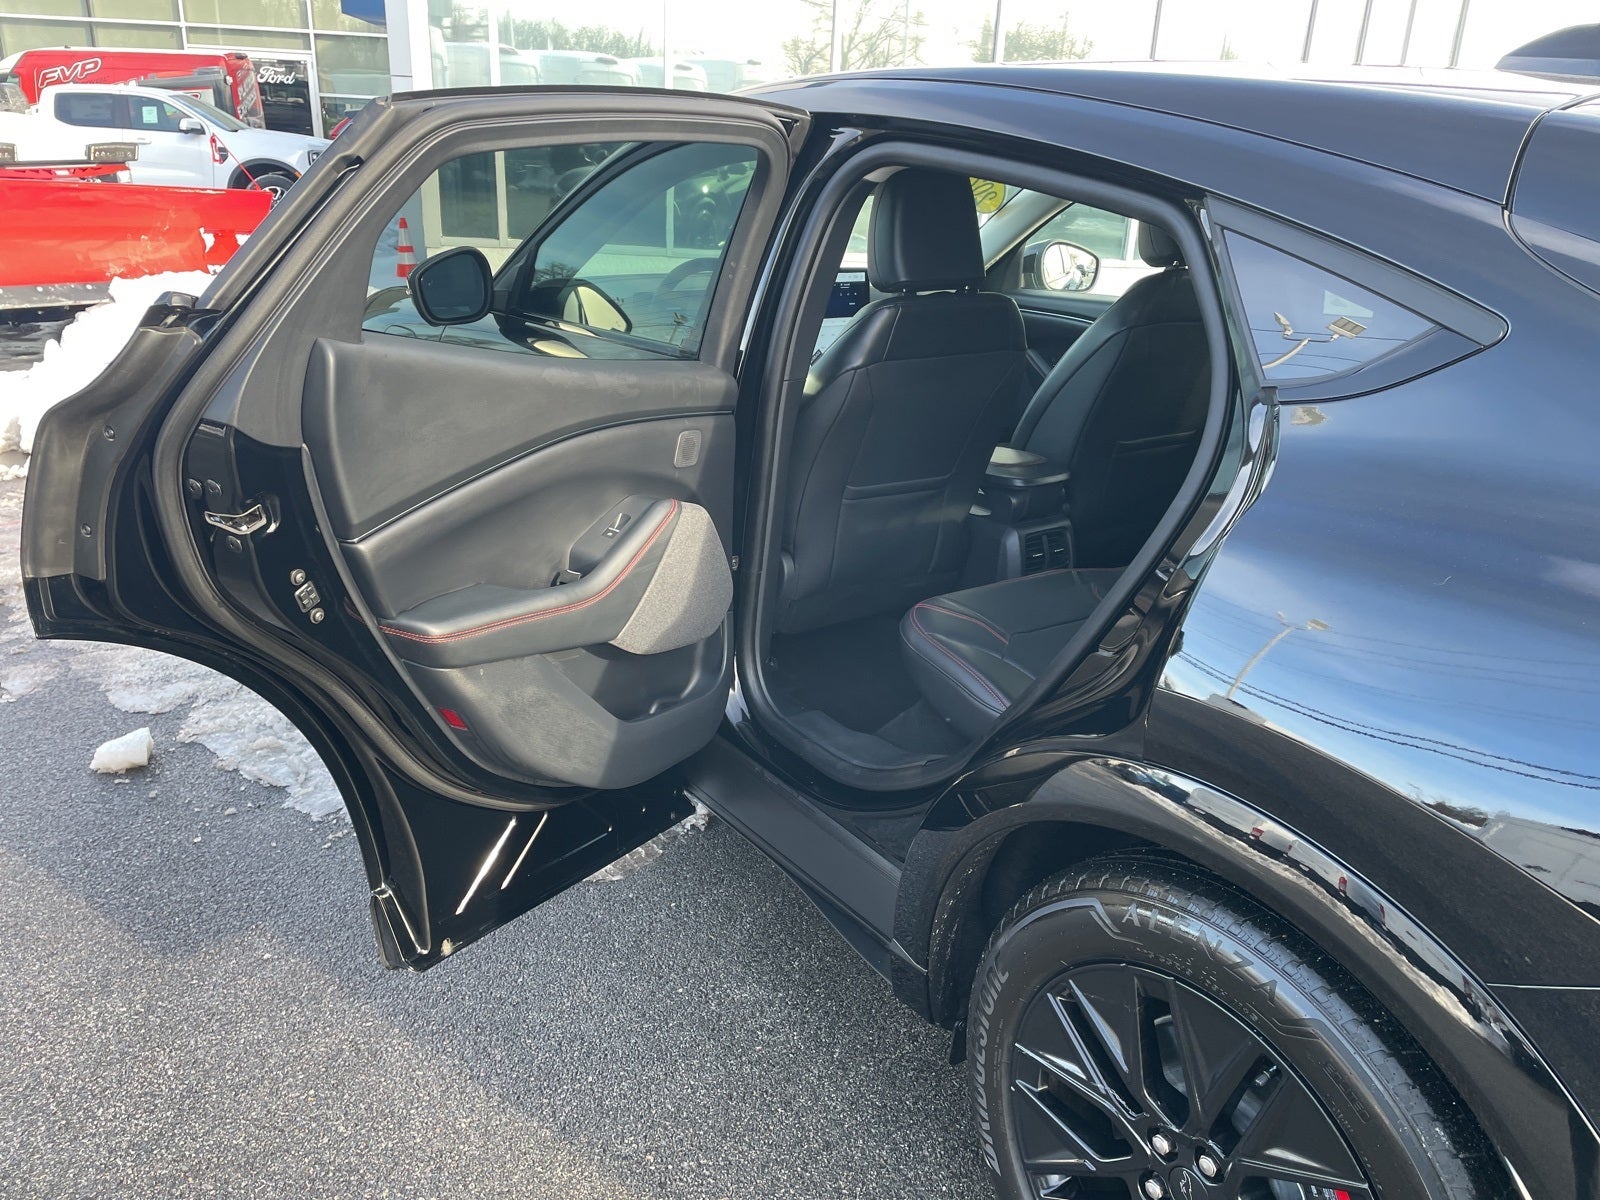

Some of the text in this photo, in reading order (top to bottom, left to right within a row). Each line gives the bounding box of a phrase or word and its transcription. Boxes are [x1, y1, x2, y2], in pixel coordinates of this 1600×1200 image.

[38, 57, 102, 88] FVP
[257, 66, 295, 85] Ford
[1121, 903, 1278, 1003] ALENZA
[973, 959, 1010, 1177] BRIDGESTONE
